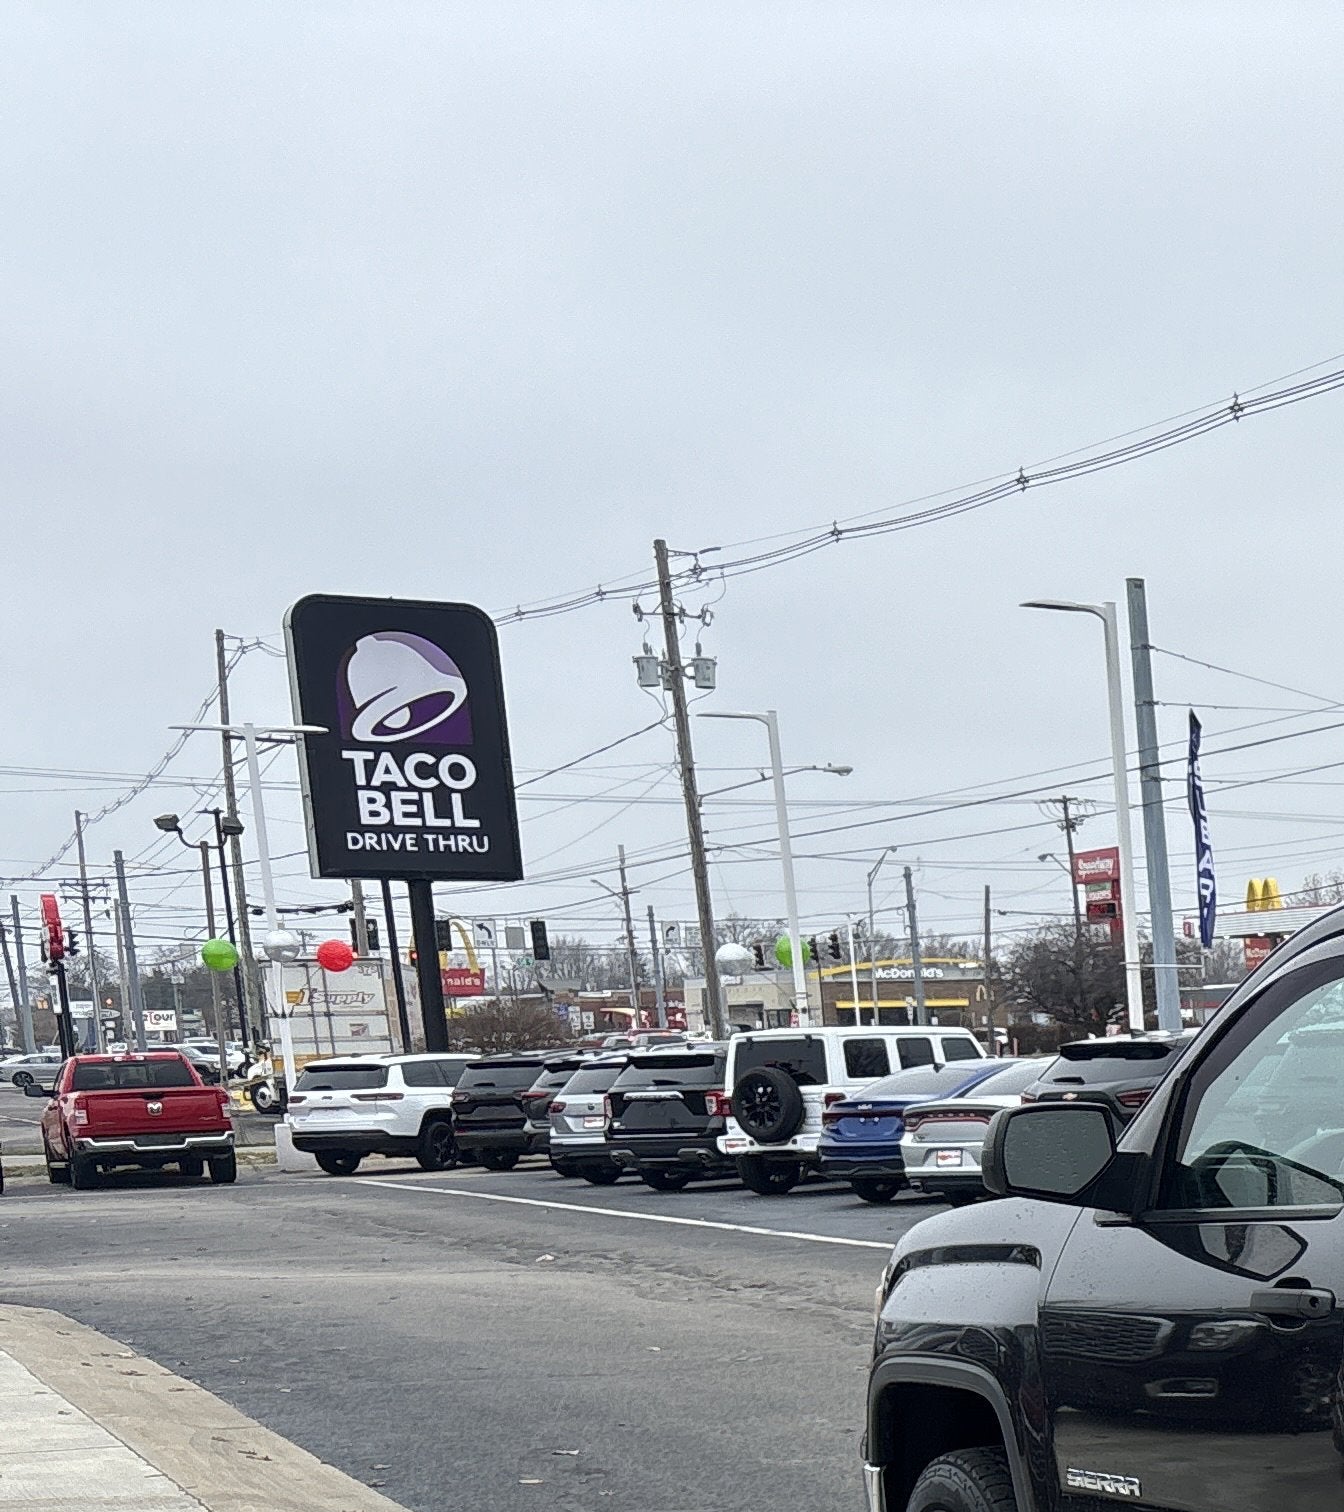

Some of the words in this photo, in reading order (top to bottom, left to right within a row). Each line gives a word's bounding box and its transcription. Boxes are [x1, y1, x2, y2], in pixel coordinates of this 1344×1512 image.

[341, 750, 477, 790] TACO
[357, 789, 481, 828] BELL
[346, 832, 419, 851] DRIVE
[423, 834, 489, 853] THRU
[873, 967, 944, 979] McDonld's
[1066, 1467, 1142, 1498] SIERRA
